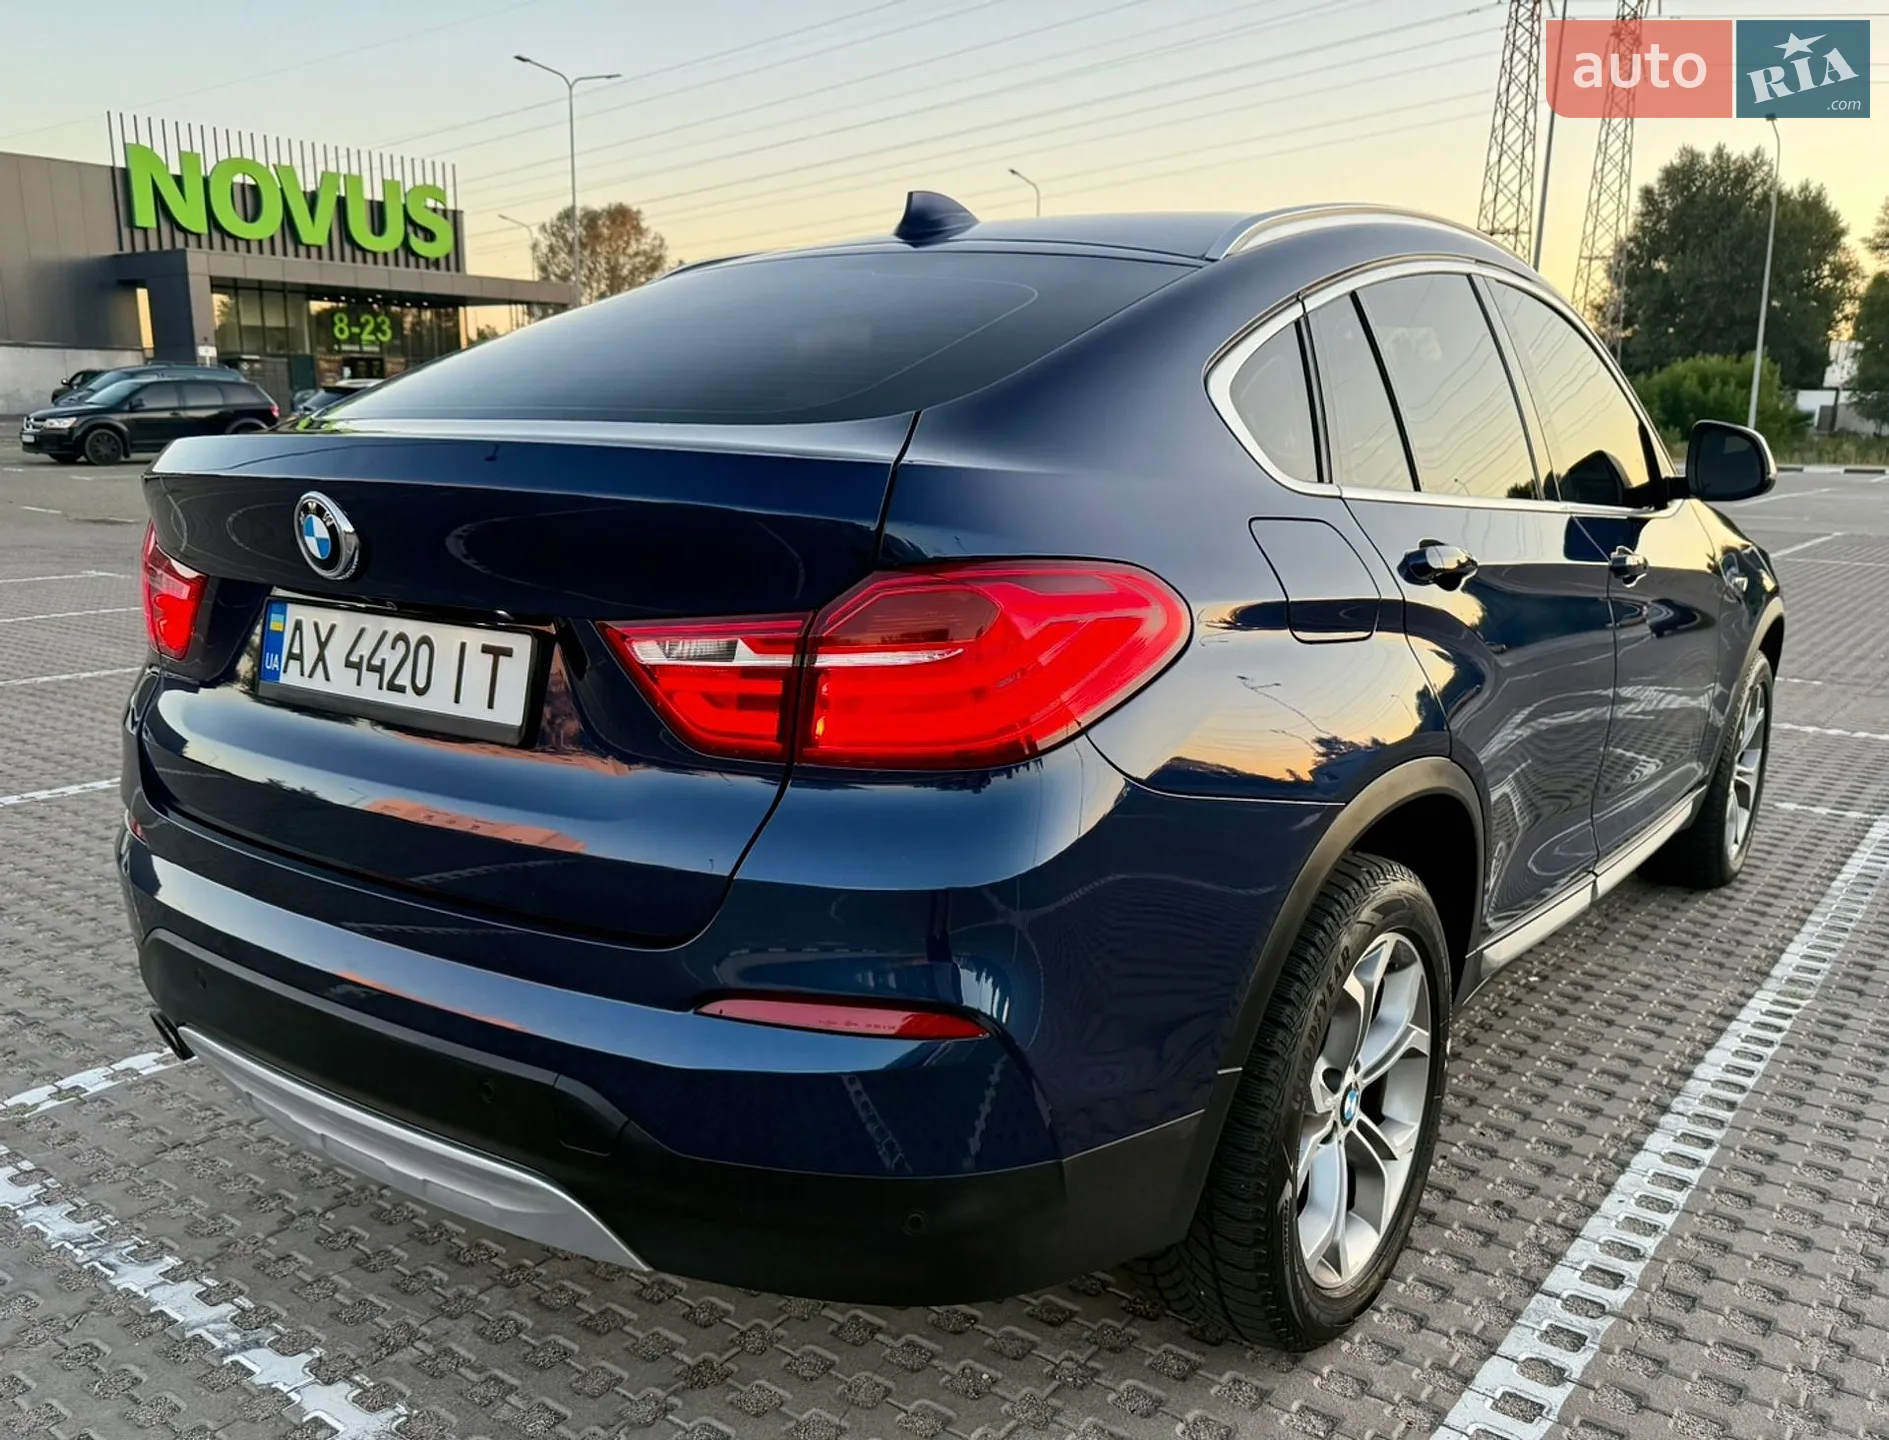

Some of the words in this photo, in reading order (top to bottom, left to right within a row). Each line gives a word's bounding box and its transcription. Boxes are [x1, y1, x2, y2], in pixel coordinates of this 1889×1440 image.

[125, 142, 454, 259] NOVUS
[332, 312, 393, 342] 8-23
[265, 652, 279, 671] UA
[283, 618, 337, 682] AX
[344, 627, 435, 696] 4420
[454, 641, 513, 709] IT
